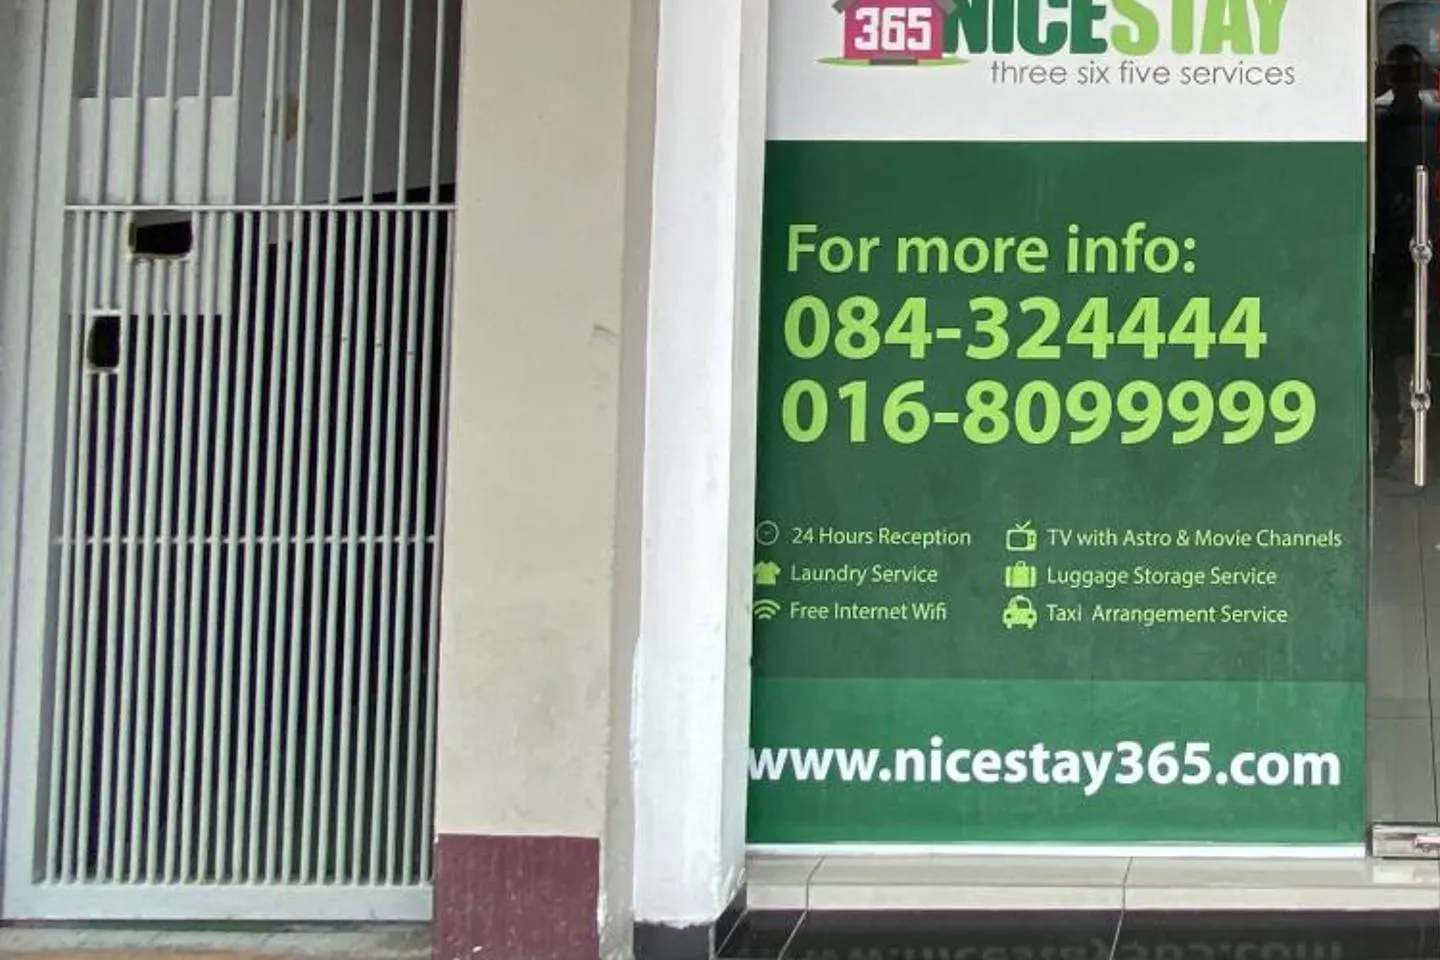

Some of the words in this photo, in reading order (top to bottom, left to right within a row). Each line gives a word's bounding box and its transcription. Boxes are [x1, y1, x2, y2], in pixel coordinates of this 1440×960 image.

[853, 6, 932, 52] 365
[991, 60, 1067, 86] three
[1077, 60, 1110, 86] six
[1120, 60, 1172, 86] five
[1180, 61, 1295, 86] services
[786, 222, 880, 274] For
[897, 236, 1049, 274] more
[1066, 221, 1196, 274] info:
[783, 295, 1268, 360] 084-324444
[780, 378, 1317, 445] 016-8099999
[791, 527, 814, 546] 24
[818, 527, 874, 546] Hours
[878, 527, 971, 549] Reception
[1046, 529, 1073, 547] TV
[1076, 528, 1118, 547] with
[1122, 529, 1172, 547] Astro
[1176, 529, 1191, 547] &
[1195, 529, 1252, 547] Movie
[1256, 529, 1343, 547] Channels
[791, 565, 868, 587] Laundry
[872, 564, 939, 583] Service
[1046, 567, 1129, 590] Luggage
[1133, 567, 1205, 590] Storage
[1210, 567, 1277, 586] Service
[790, 602, 829, 620] Free
[834, 601, 908, 620] Internet
[912, 601, 947, 620] Wifi
[1046, 604, 1082, 623] Taxi
[1091, 604, 1216, 627] Arrangement
[1220, 604, 1288, 623] Service
[749, 735, 1341, 796] www.nicestay365.com
